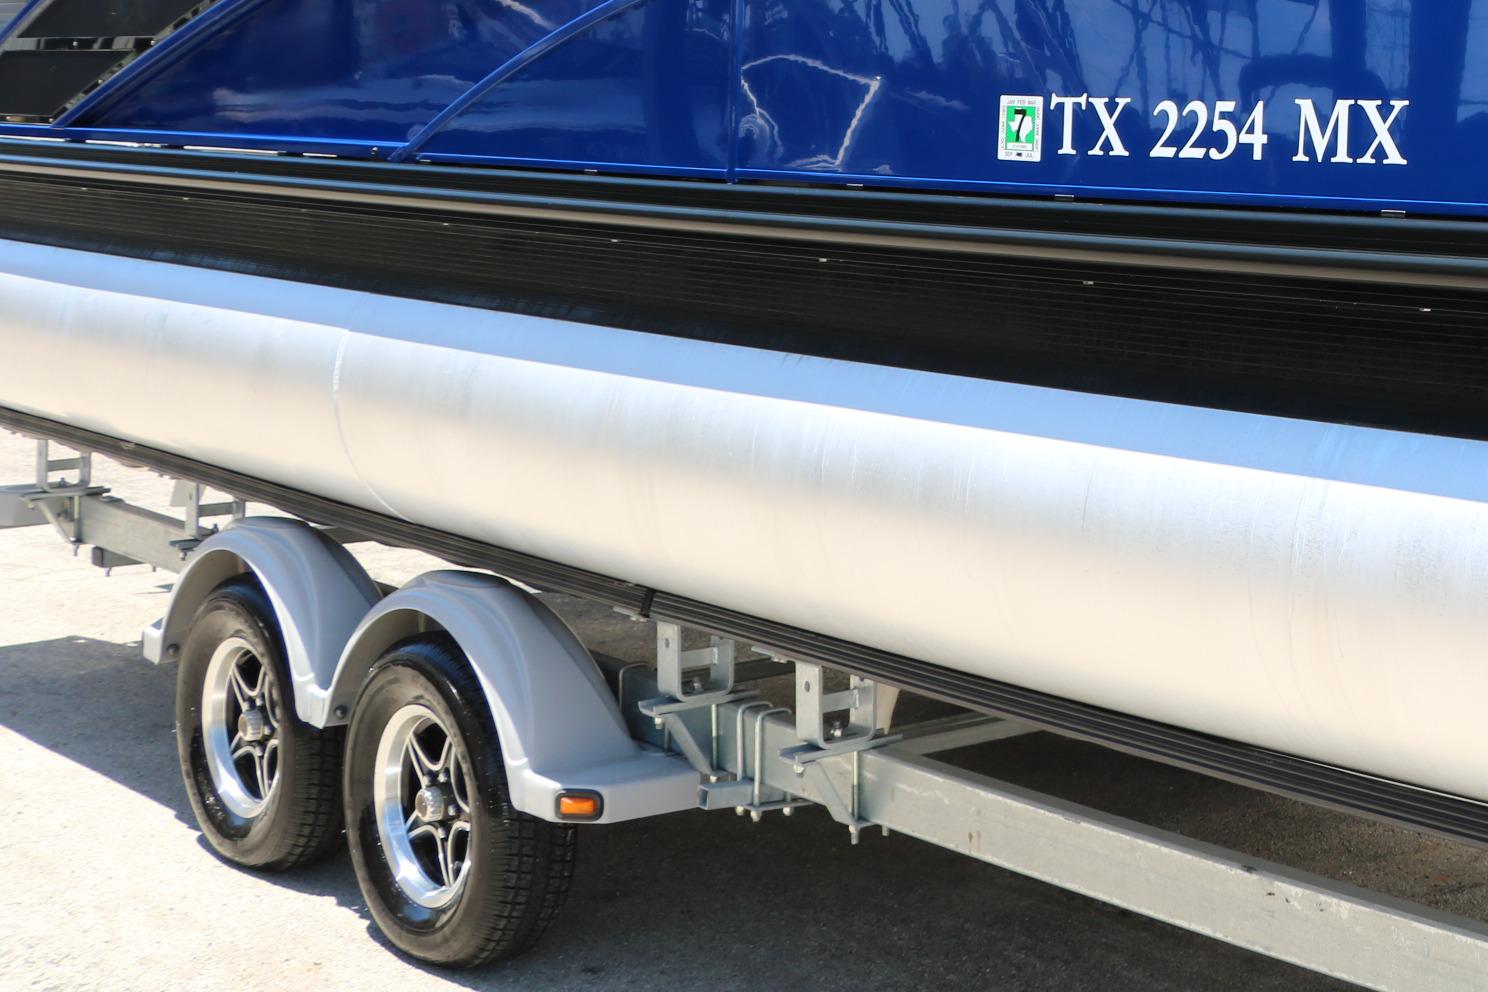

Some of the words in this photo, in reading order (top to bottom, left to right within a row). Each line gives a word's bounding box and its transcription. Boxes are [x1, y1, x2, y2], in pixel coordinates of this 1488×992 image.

[1013, 108, 1027, 143] 7
[1049, 92, 1132, 157] TX
[1149, 100, 1268, 161] 2254
[1292, 98, 1410, 165] MX
